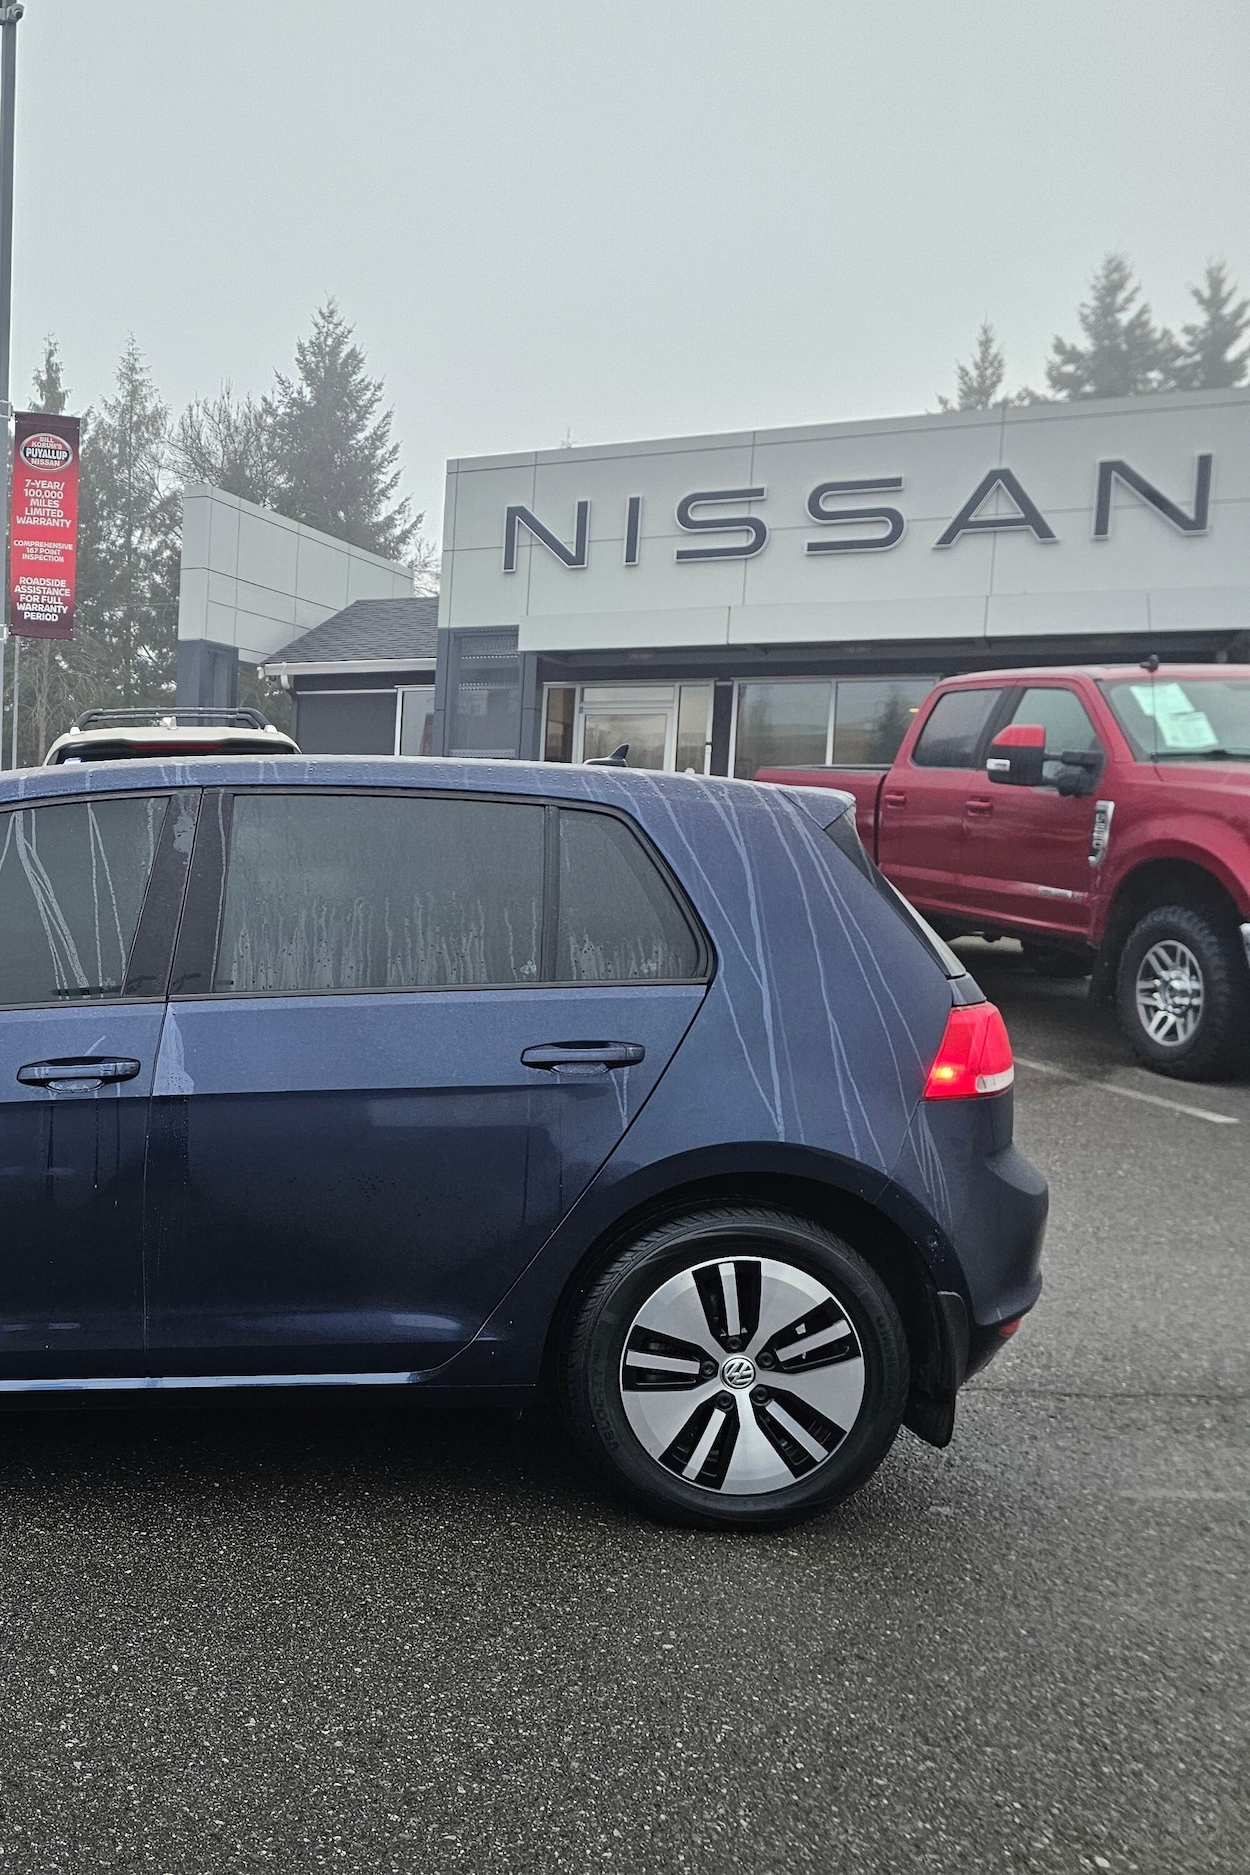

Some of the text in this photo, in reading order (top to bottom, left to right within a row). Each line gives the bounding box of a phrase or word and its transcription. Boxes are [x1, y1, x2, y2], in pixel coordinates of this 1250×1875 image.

[31, 441, 62, 449] KORUM'S
[26, 447, 67, 460] PUYALLUP
[31, 459, 60, 467] NISSAN
[25, 479, 65, 490] 7-YEAR/
[24, 488, 64, 499] 100,000
[30, 498, 59, 508] MILES
[25, 507, 64, 517] LIMITED
[502, 453, 1213, 573] NISSAN
[16, 516, 71, 528] WARRANTY
[14, 540, 73, 550] COMPREHENSIVE
[22, 553, 64, 563] INSPECTION
[19, 576, 66, 587] ROADSIDE
[14, 585, 70, 597] ASSISTANCE
[20, 594, 63, 605] FOR FULL
[16, 602, 68, 614] WARRANTY
[24, 612, 58, 622] PERIOD
